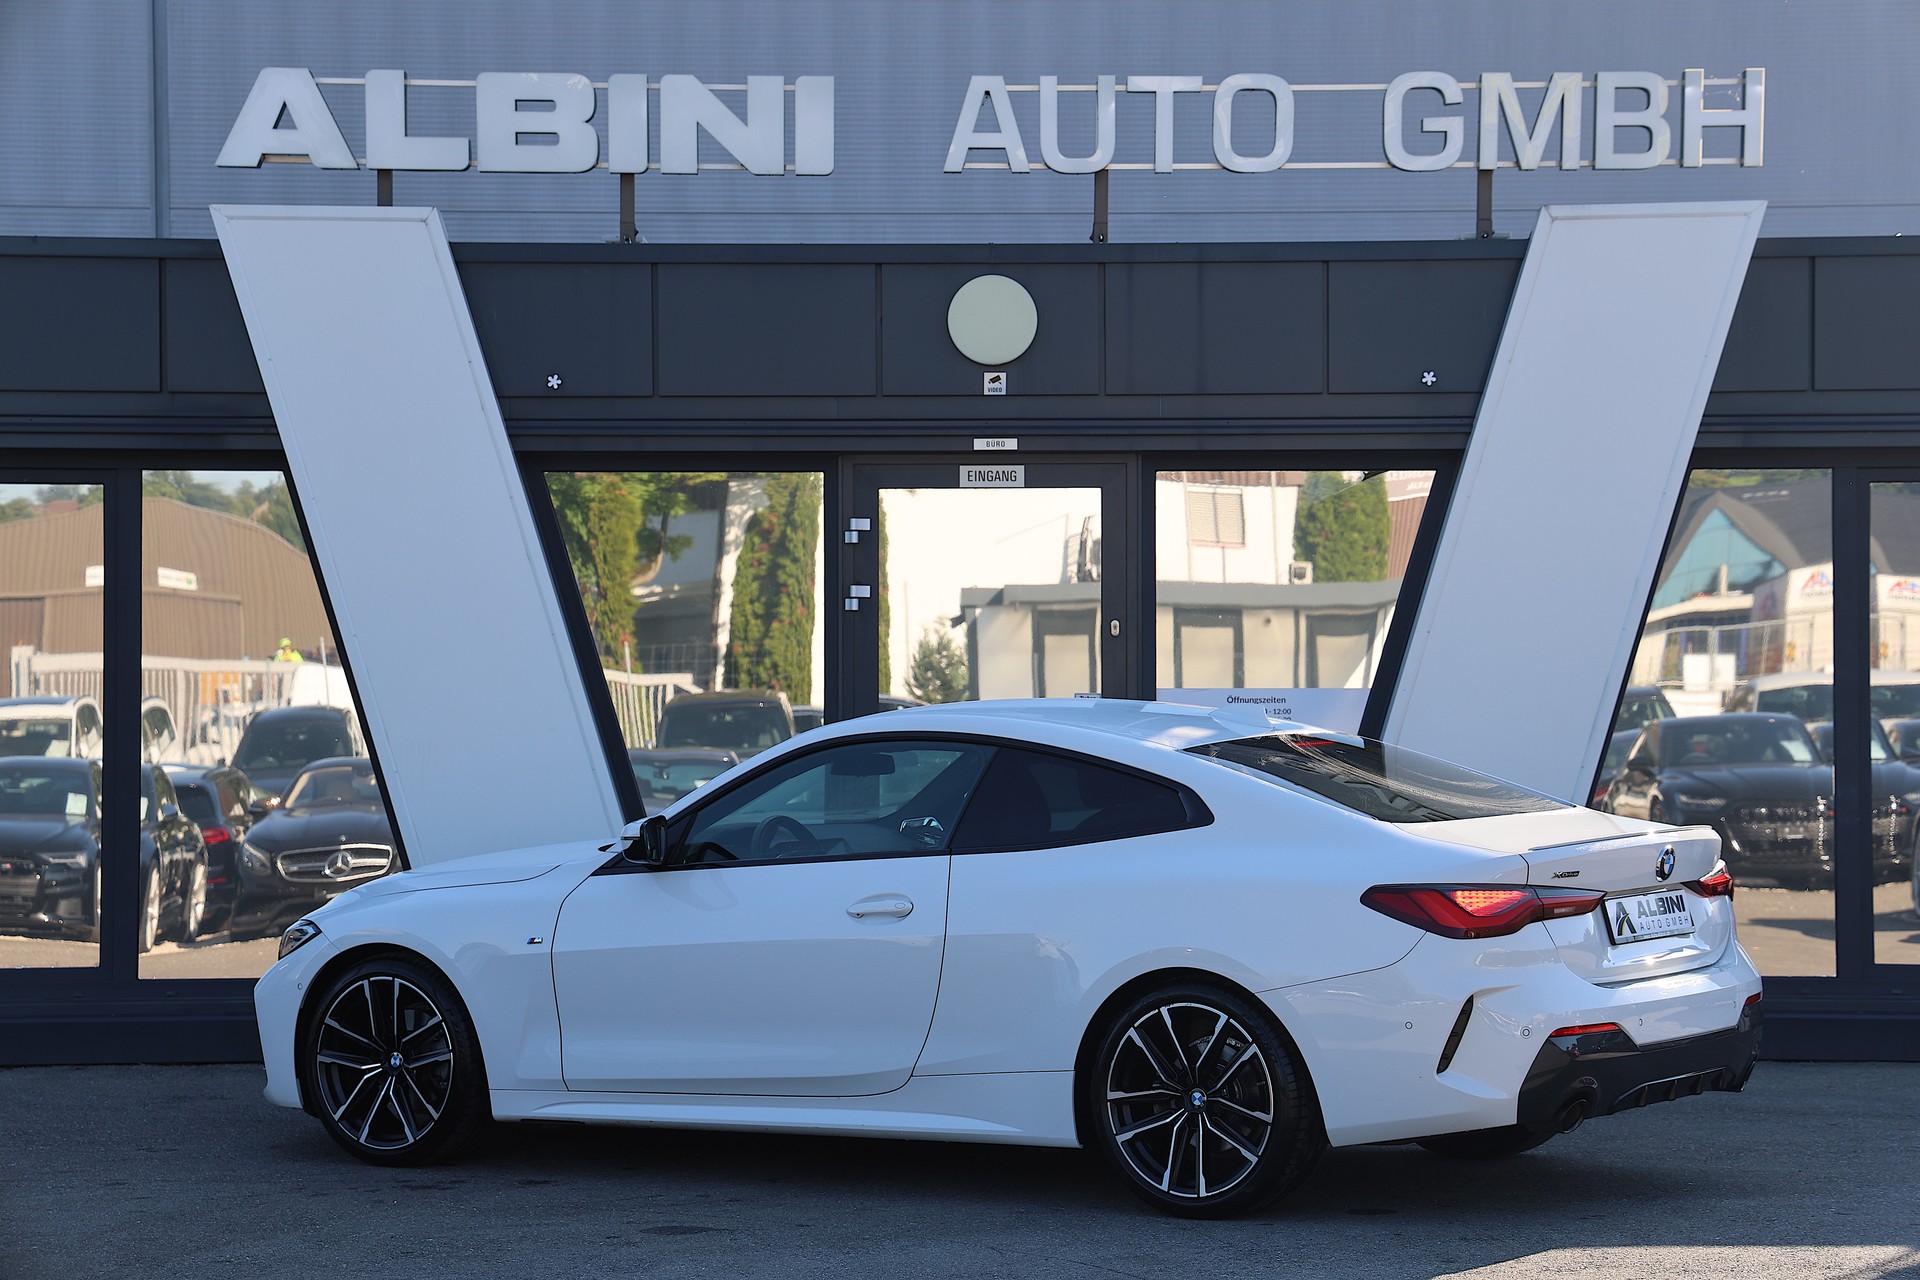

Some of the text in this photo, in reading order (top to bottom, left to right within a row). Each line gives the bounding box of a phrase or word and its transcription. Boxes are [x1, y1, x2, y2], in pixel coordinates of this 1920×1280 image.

[215, 66, 1766, 176] ALBINI AUTO GMBH
[967, 470, 1017, 482] EINGANG
[1226, 695, 1287, 704] Öffnungszeiten
[1638, 895, 1686, 919] ALBINI
[1640, 915, 1689, 931] AUTO GMBH
